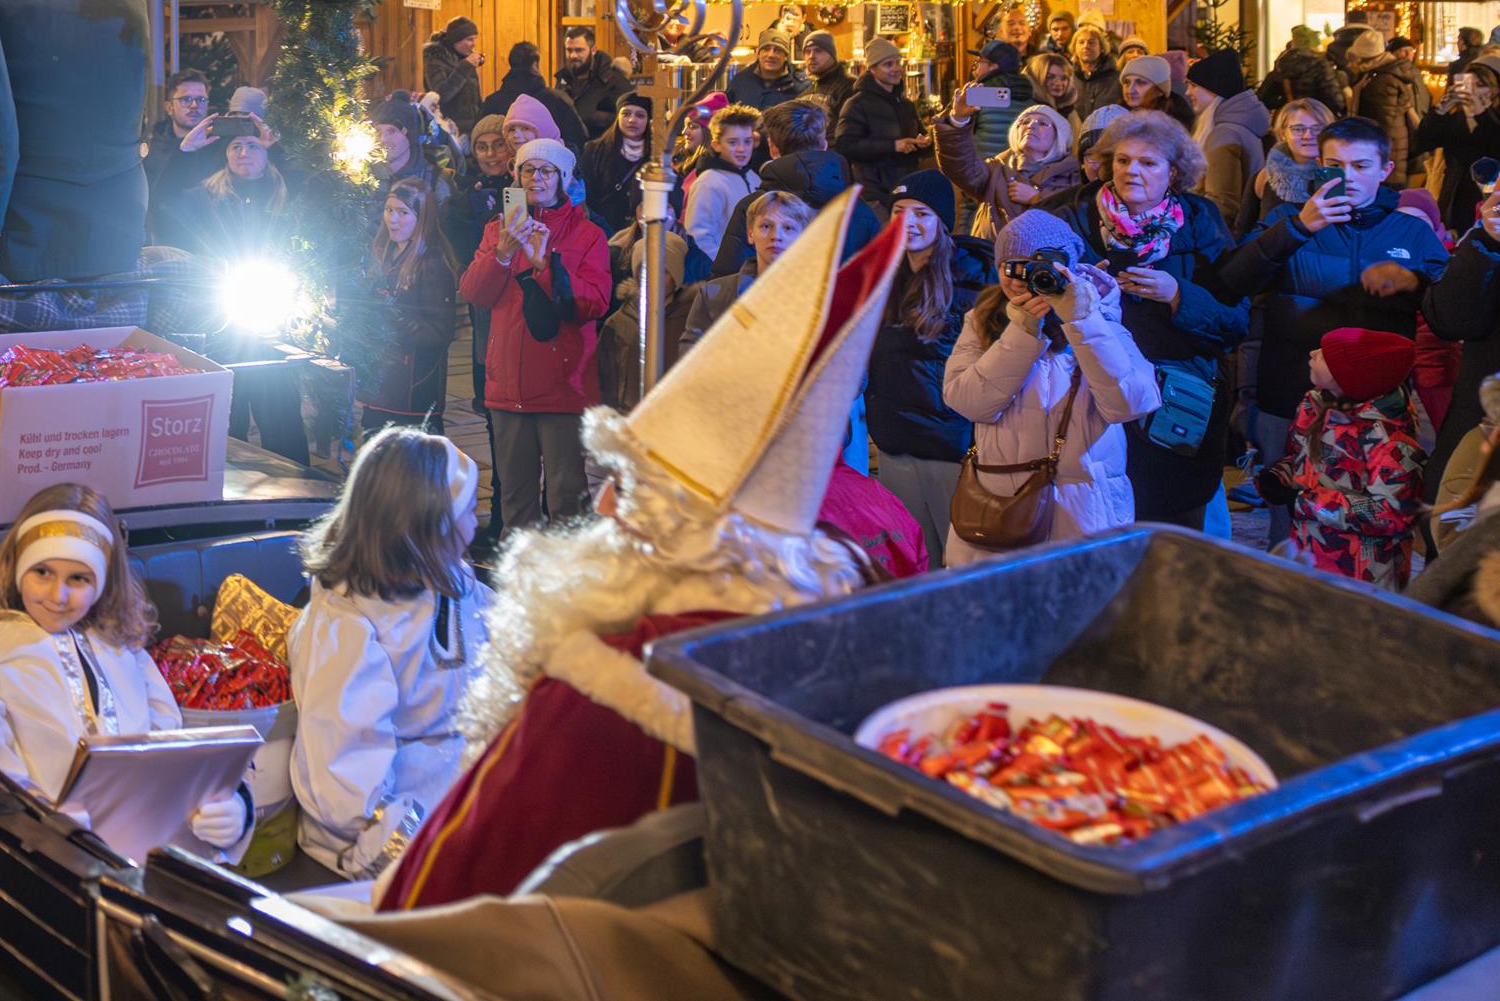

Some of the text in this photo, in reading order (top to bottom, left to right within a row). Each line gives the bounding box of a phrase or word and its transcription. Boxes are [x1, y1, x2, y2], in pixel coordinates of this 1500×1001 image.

[20, 427, 130, 444] Kühl und trocken lagern
[151, 417, 202, 438] Storz
[19, 443, 102, 460] Keep dry and cool
[17, 463, 43, 474] Prod.
[51, 460, 92, 473] Germany
